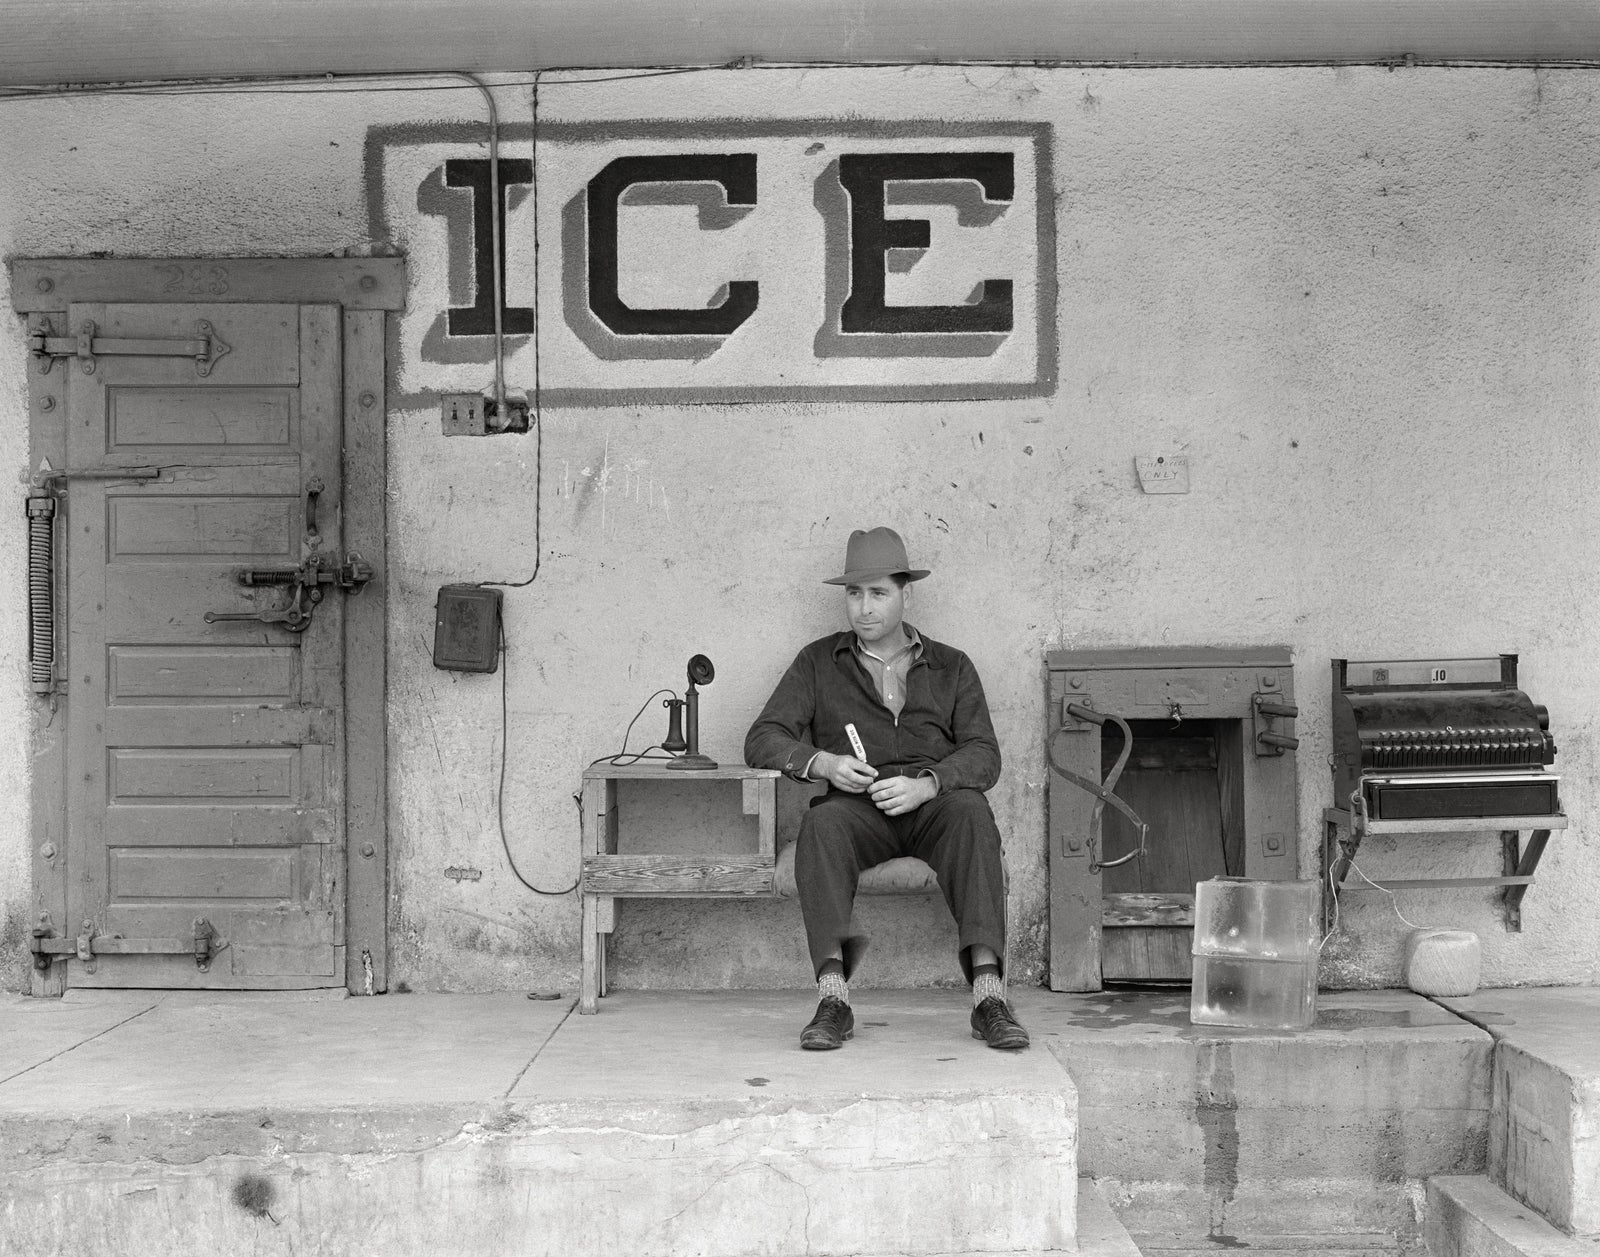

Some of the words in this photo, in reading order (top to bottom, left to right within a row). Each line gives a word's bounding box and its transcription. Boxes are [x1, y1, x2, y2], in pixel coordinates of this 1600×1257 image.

[417, 153, 1014, 362] ICE
[1144, 470, 1178, 480] ONLY
[1433, 670, 1446, 681] .10
